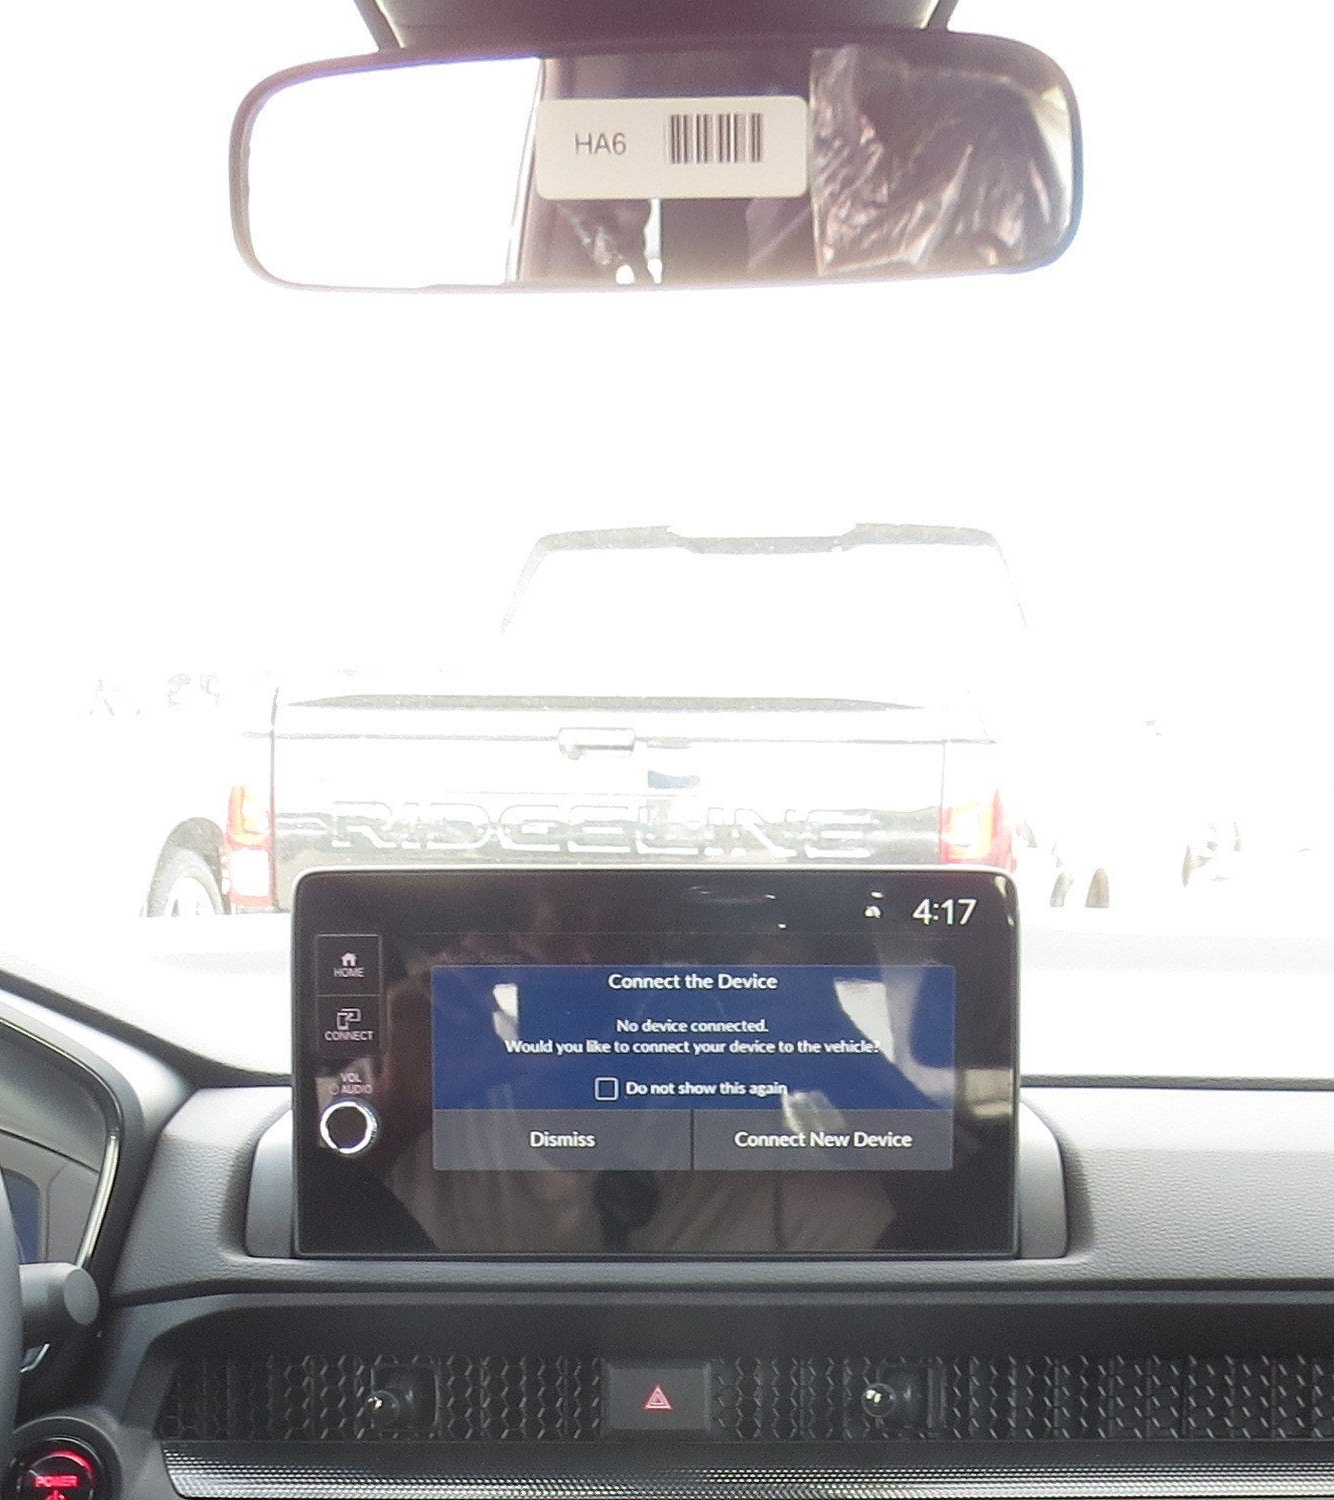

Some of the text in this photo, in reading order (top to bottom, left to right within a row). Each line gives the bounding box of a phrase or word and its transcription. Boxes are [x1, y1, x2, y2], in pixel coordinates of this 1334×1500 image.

[575, 133, 627, 155] HA6
[913, 898, 977, 925] 4:17
[333, 967, 365, 978] HOME
[608, 972, 779, 990] Connect the Device
[616, 1019, 769, 1033] No device connected.
[324, 1030, 374, 1041] CONNECT
[505, 1039, 547, 1054] Would
[549, 1043, 583, 1057] you
[585, 1039, 611, 1054] like
[614, 1041, 631, 1054] to
[632, 1041, 690, 1054] connect
[692, 1042, 727, 1056] your
[729, 1040, 776, 1054] device
[778, 1041, 795, 1054] to
[797, 1040, 822, 1054] the
[340, 1072, 362, 1083] VOL
[341, 1084, 373, 1095] AUDIO
[626, 1081, 788, 1098] Do not show this again
[529, 1130, 596, 1148] Dismiss
[734, 1131, 914, 1148] Connect New Device
[35, 1475, 78, 1488] POWER
